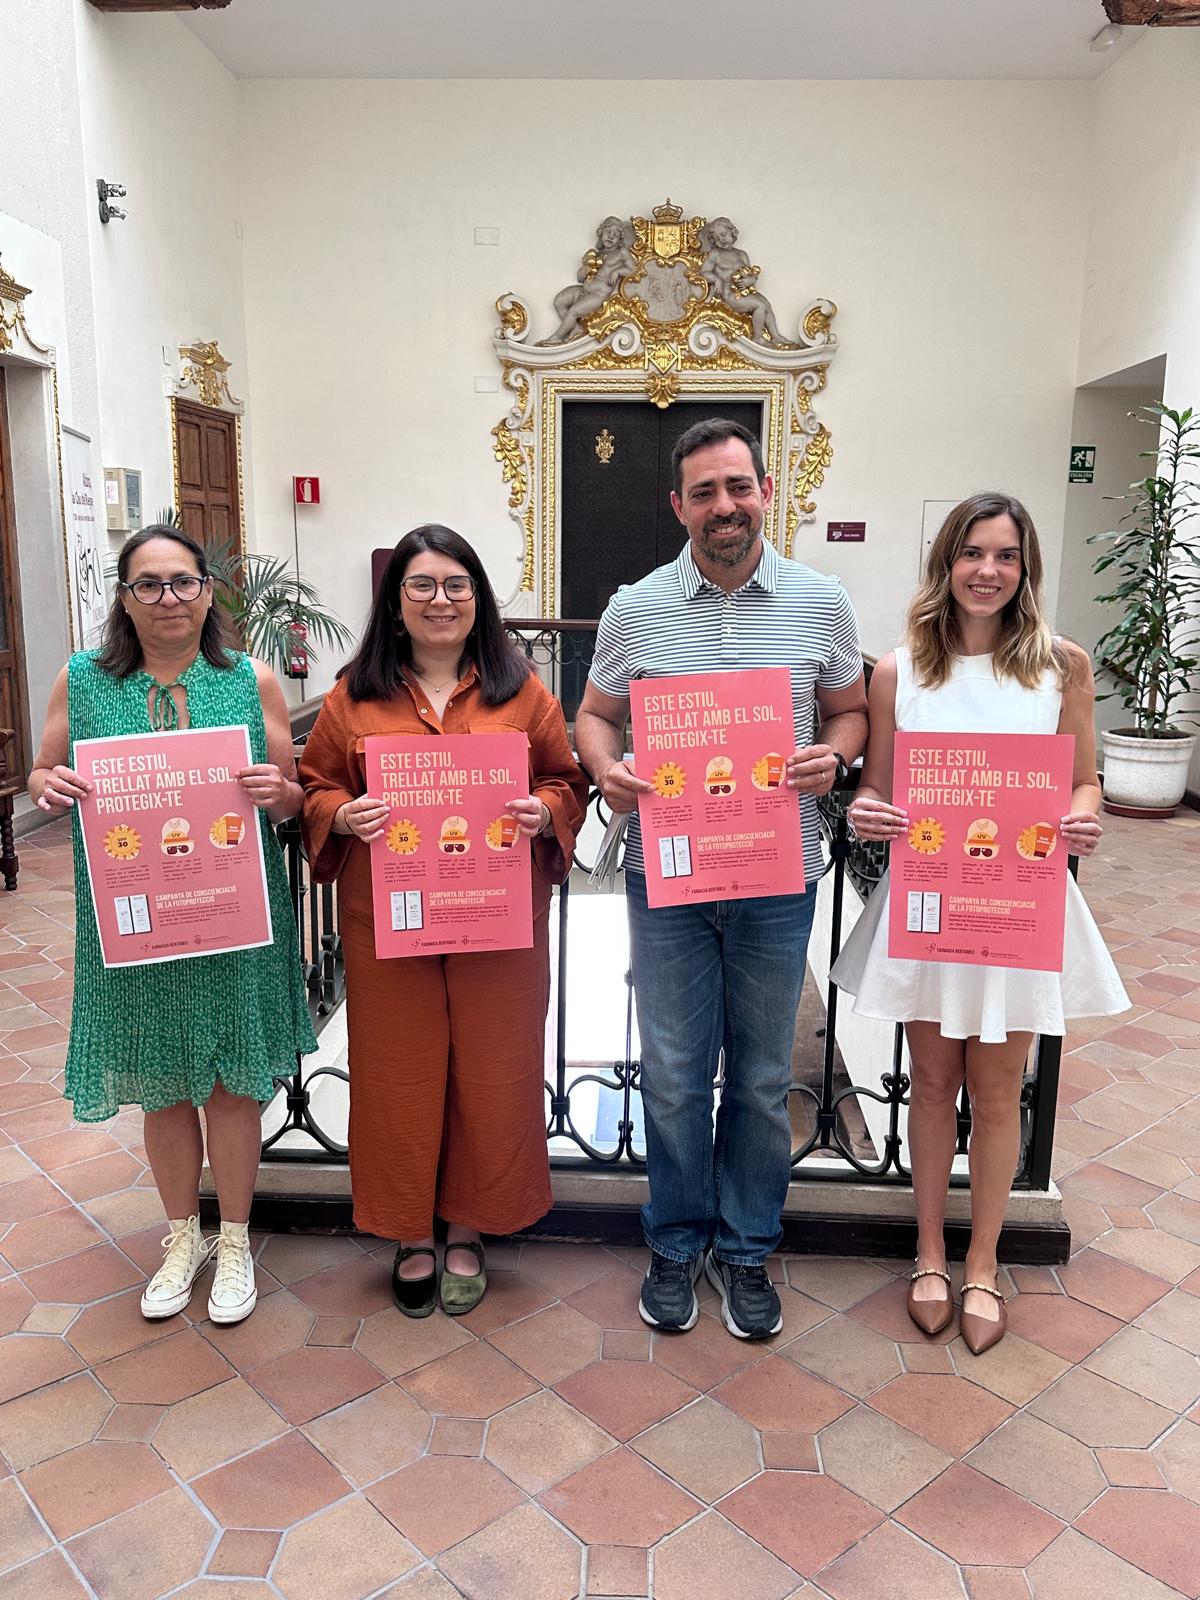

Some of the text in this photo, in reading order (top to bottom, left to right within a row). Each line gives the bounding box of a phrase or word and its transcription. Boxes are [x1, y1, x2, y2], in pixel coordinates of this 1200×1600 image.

[644, 692, 718, 712] ESTE ESTIU,
[645, 705, 781, 732] TRELLAT AMB EL SOL,
[647, 729, 727, 751] PROTEGIX-TE
[92, 753, 172, 776] ESTE ESTIU,
[380, 752, 456, 770] ESTE ESTIU,
[909, 749, 990, 769] ESTE ESTIU,
[94, 766, 238, 795] TRELLAT AMB EL SOL,
[381, 769, 517, 788] TRELLAT AMB EL SOL,
[909, 769, 1058, 791] TRELLAT AMB EL SOL,
[96, 791, 183, 815] PROTEGIX-TE
[382, 789, 463, 808] PROTEGIX-TE
[908, 788, 996, 808] PROTEGIX-TE
[697, 835, 724, 844] CAMPANYA
[155, 892, 185, 902] CAMPANYA
[156, 900, 164, 909] DE
[949, 897, 980, 906] CAMPANYA
[981, 898, 989, 906] DE
